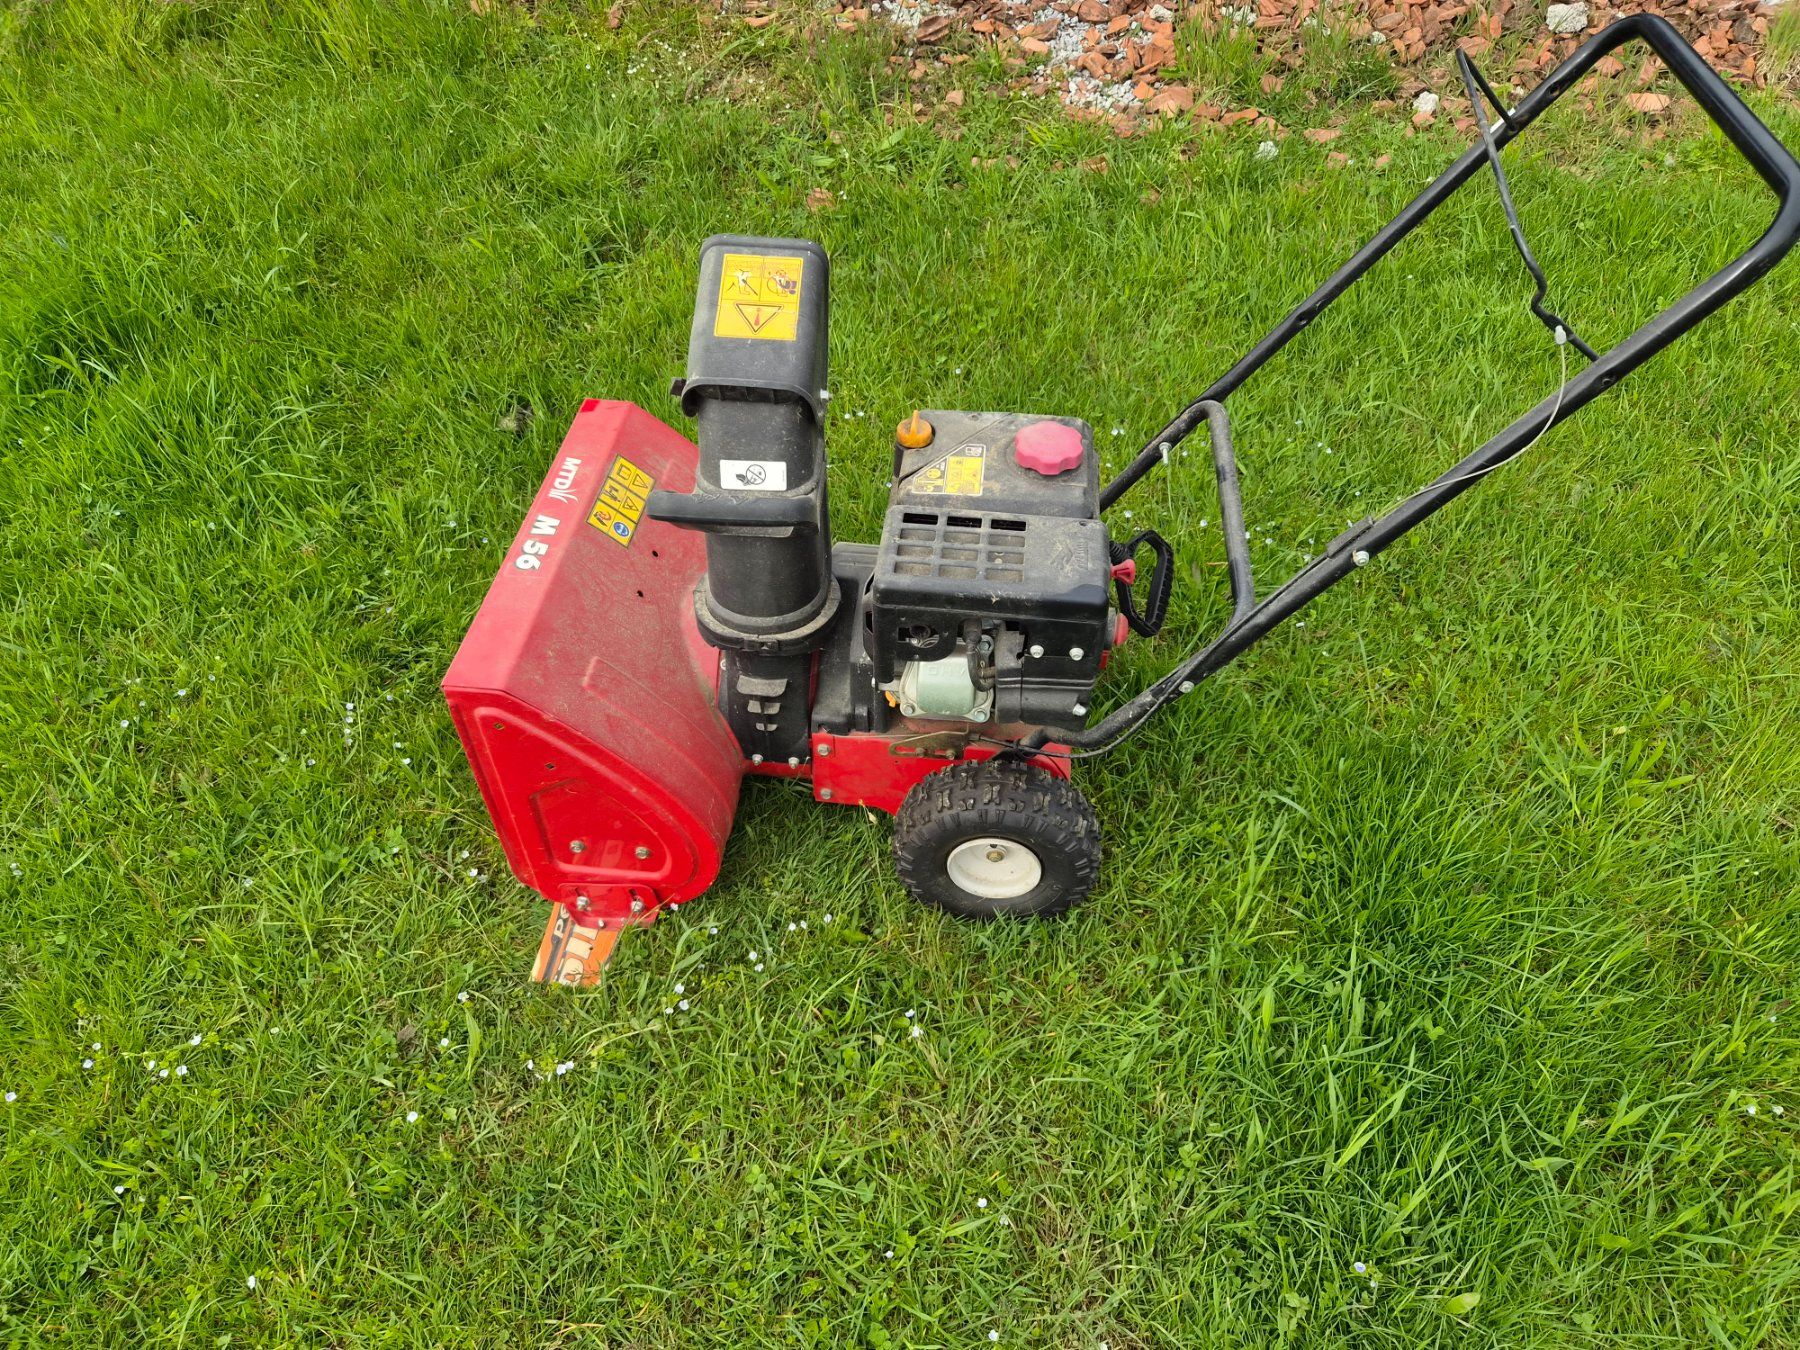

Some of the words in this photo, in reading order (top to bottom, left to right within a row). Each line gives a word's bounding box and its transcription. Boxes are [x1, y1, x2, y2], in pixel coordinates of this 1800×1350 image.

[553, 457, 581, 490] MTD
[530, 514, 560, 535] M
[515, 539, 549, 570] 56
